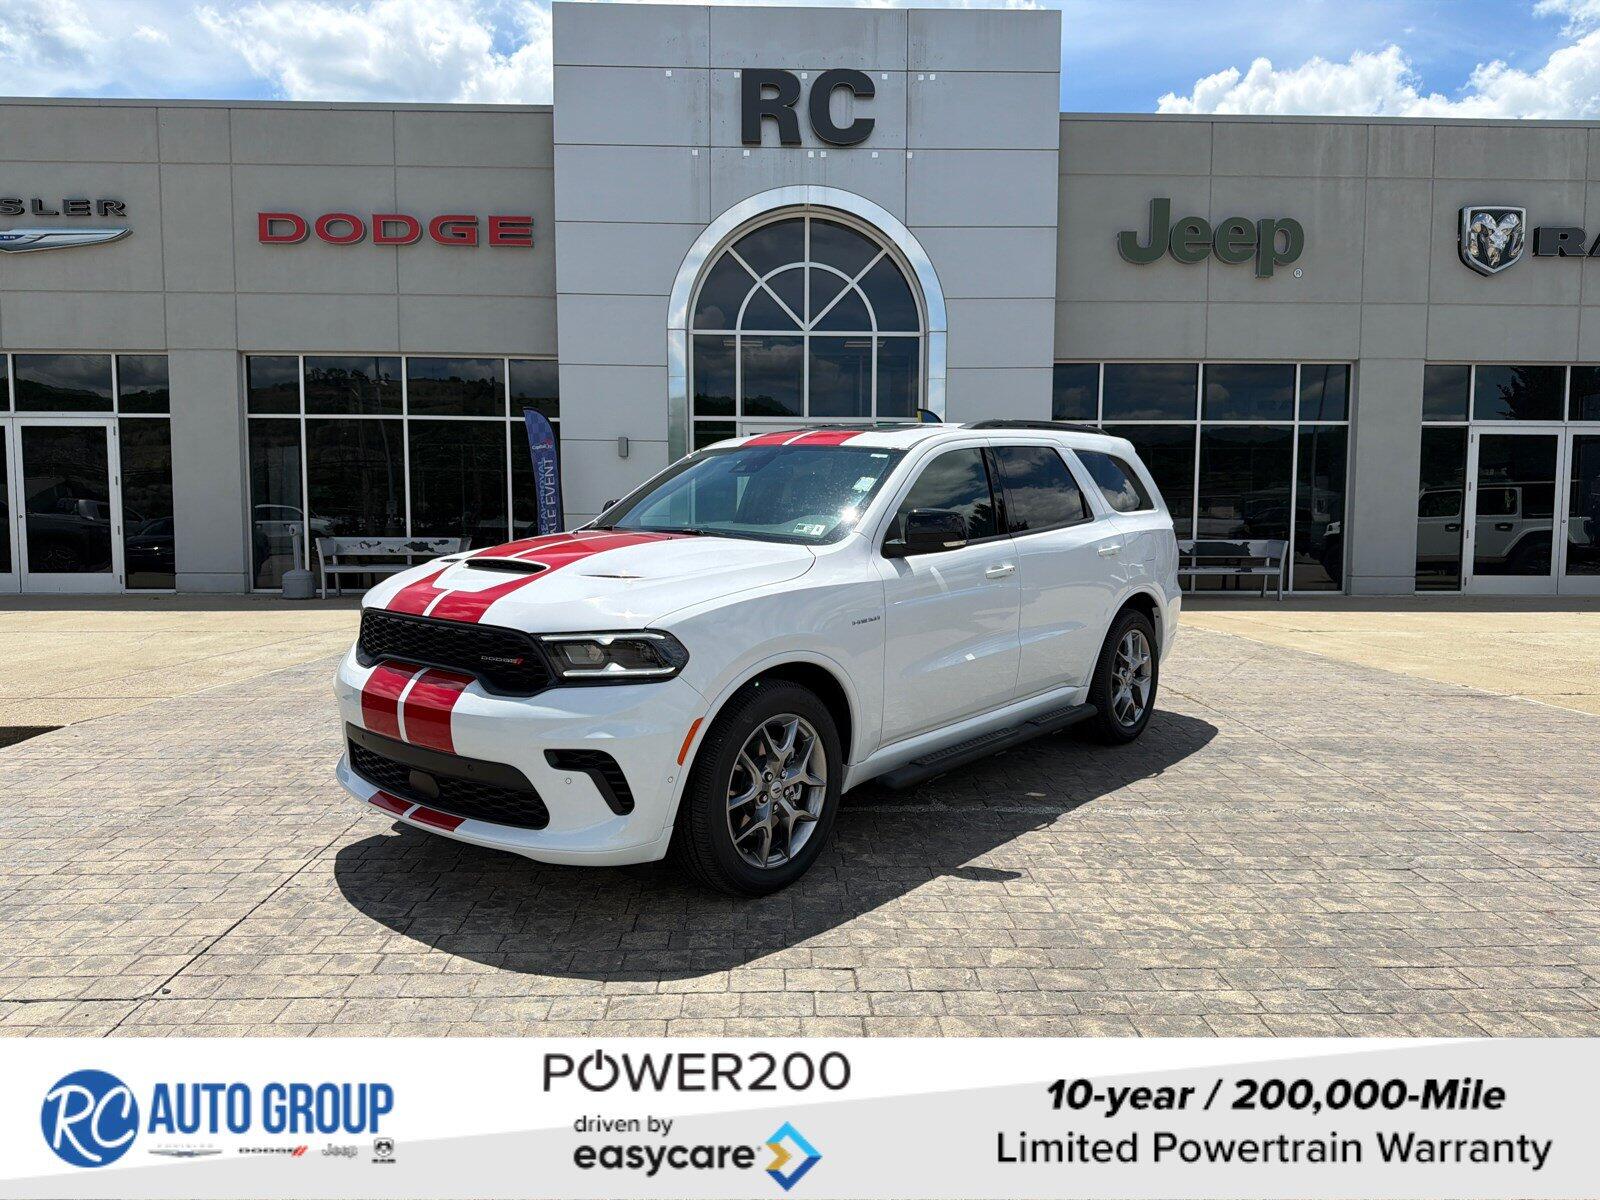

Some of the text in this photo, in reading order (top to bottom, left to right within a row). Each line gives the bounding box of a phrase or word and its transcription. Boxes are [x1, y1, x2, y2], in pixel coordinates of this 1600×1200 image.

[741, 68, 876, 147] RC
[258, 213, 534, 247] DODGE
[1117, 198, 1304, 278] Jeep
[1533, 226, 1600, 257] R
[543, 456, 556, 505] EVENT
